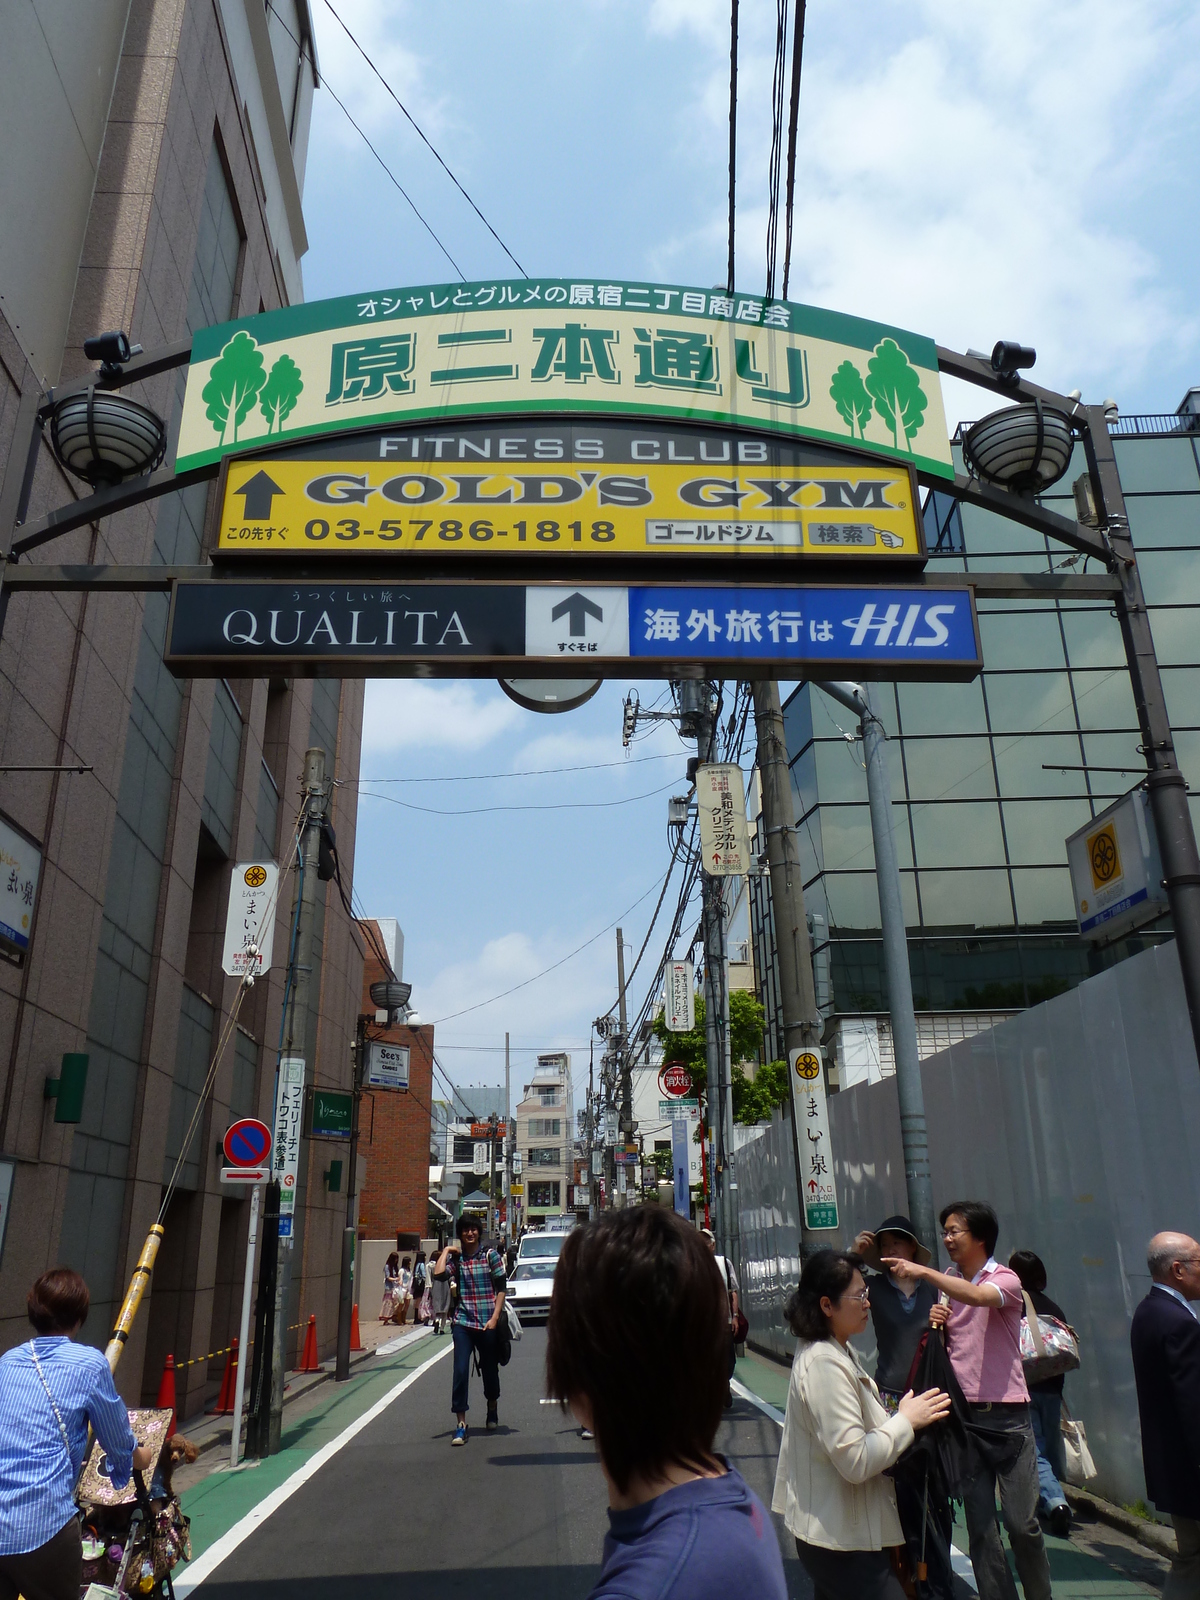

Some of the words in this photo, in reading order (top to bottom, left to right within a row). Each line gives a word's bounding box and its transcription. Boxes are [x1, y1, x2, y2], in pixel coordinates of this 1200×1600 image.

[357, 284, 791, 327] オシャレとグルメの原宿二丁目商店会
[325, 323, 811, 409] 原二本通り
[379, 437, 605, 461] FITNESS
[631, 439, 768, 463] CLUB
[304, 471, 654, 508] GOLD'S
[678, 477, 902, 511] GYM
[226, 526, 290, 542] この先すぐ
[304, 519, 616, 543] 03-5786-1818
[654, 523, 775, 543] ゴールドジム
[817, 524, 864, 544] 検索
[292, 590, 411, 603] うつくしい旅へ
[222, 609, 473, 646] QUALITA
[643, 608, 834, 643] 海外旅行は
[557, 642, 598, 653] すぐそば
[711, 807, 725, 851] クリニック
[721, 792, 737, 850] 美和メディカル
[242, 890, 266, 898] とんかつ
[380, 1048, 401, 1061] See's
[665, 1075, 690, 1087] 消火栓
[795, 1083, 824, 1095] とんかつ
[273, 1092, 290, 1171] トワコ表参道
[287, 1086, 302, 1162] フェリーチェ
[806, 1097, 828, 1176] まい泉
[819, 1185, 833, 1193] 入口
